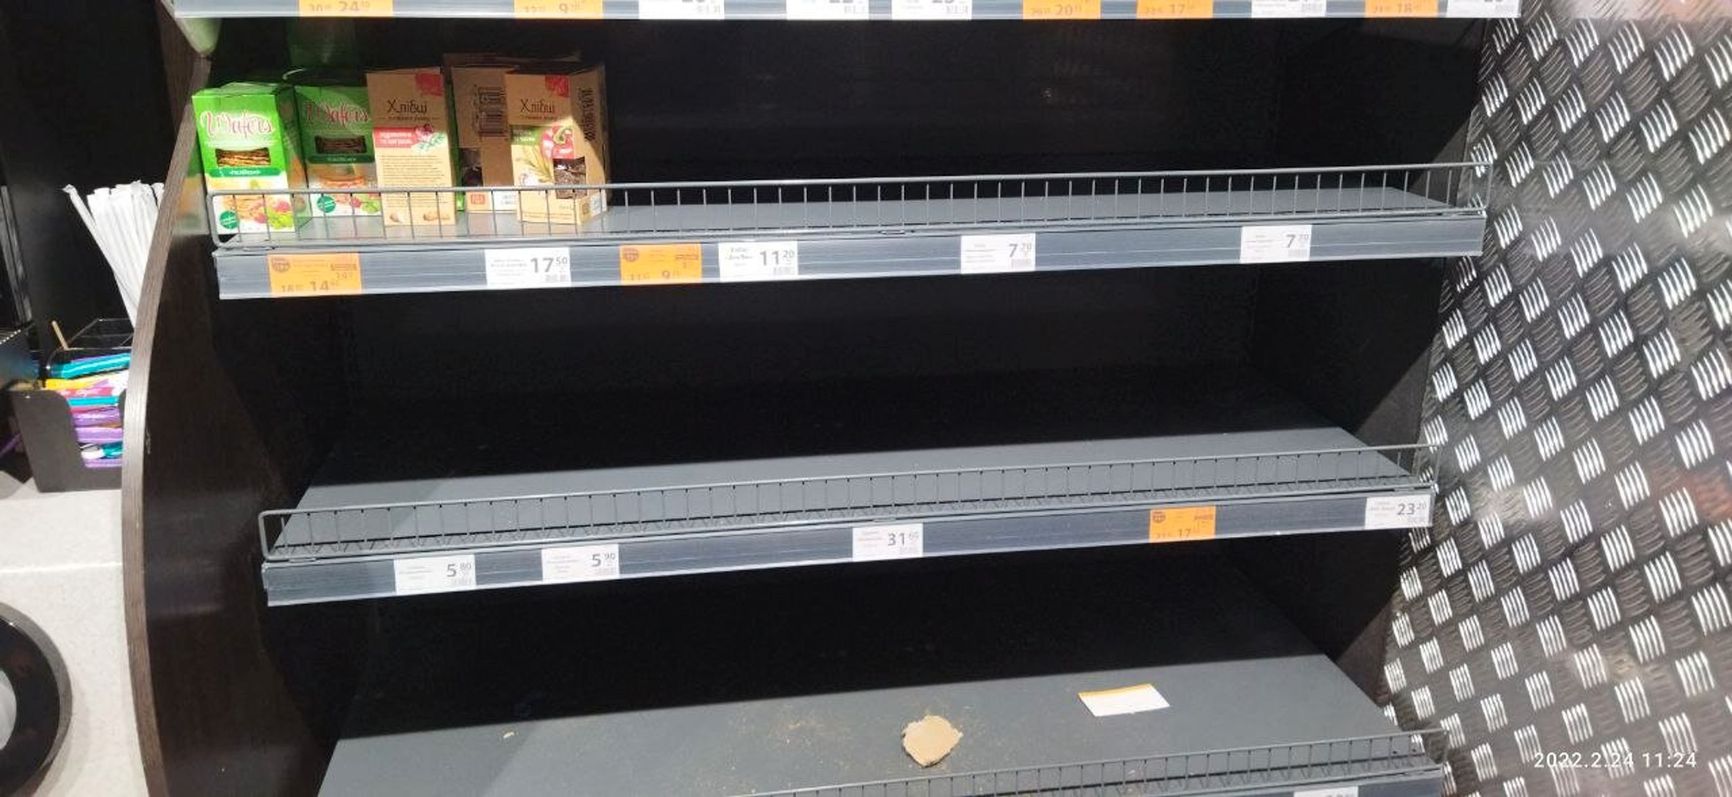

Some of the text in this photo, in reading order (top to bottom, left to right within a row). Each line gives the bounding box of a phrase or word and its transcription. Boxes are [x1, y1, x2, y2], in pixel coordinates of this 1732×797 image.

[1286, 233, 1296, 249] 7
[1008, 243, 1018, 258] 7
[530, 257, 554, 273] 17
[555, 255, 568, 265] 50
[760, 250, 779, 267] 11
[1397, 503, 1415, 516] 23
[887, 532, 906, 546] 31
[592, 553, 602, 568] 5
[446, 563, 457, 578] 5
